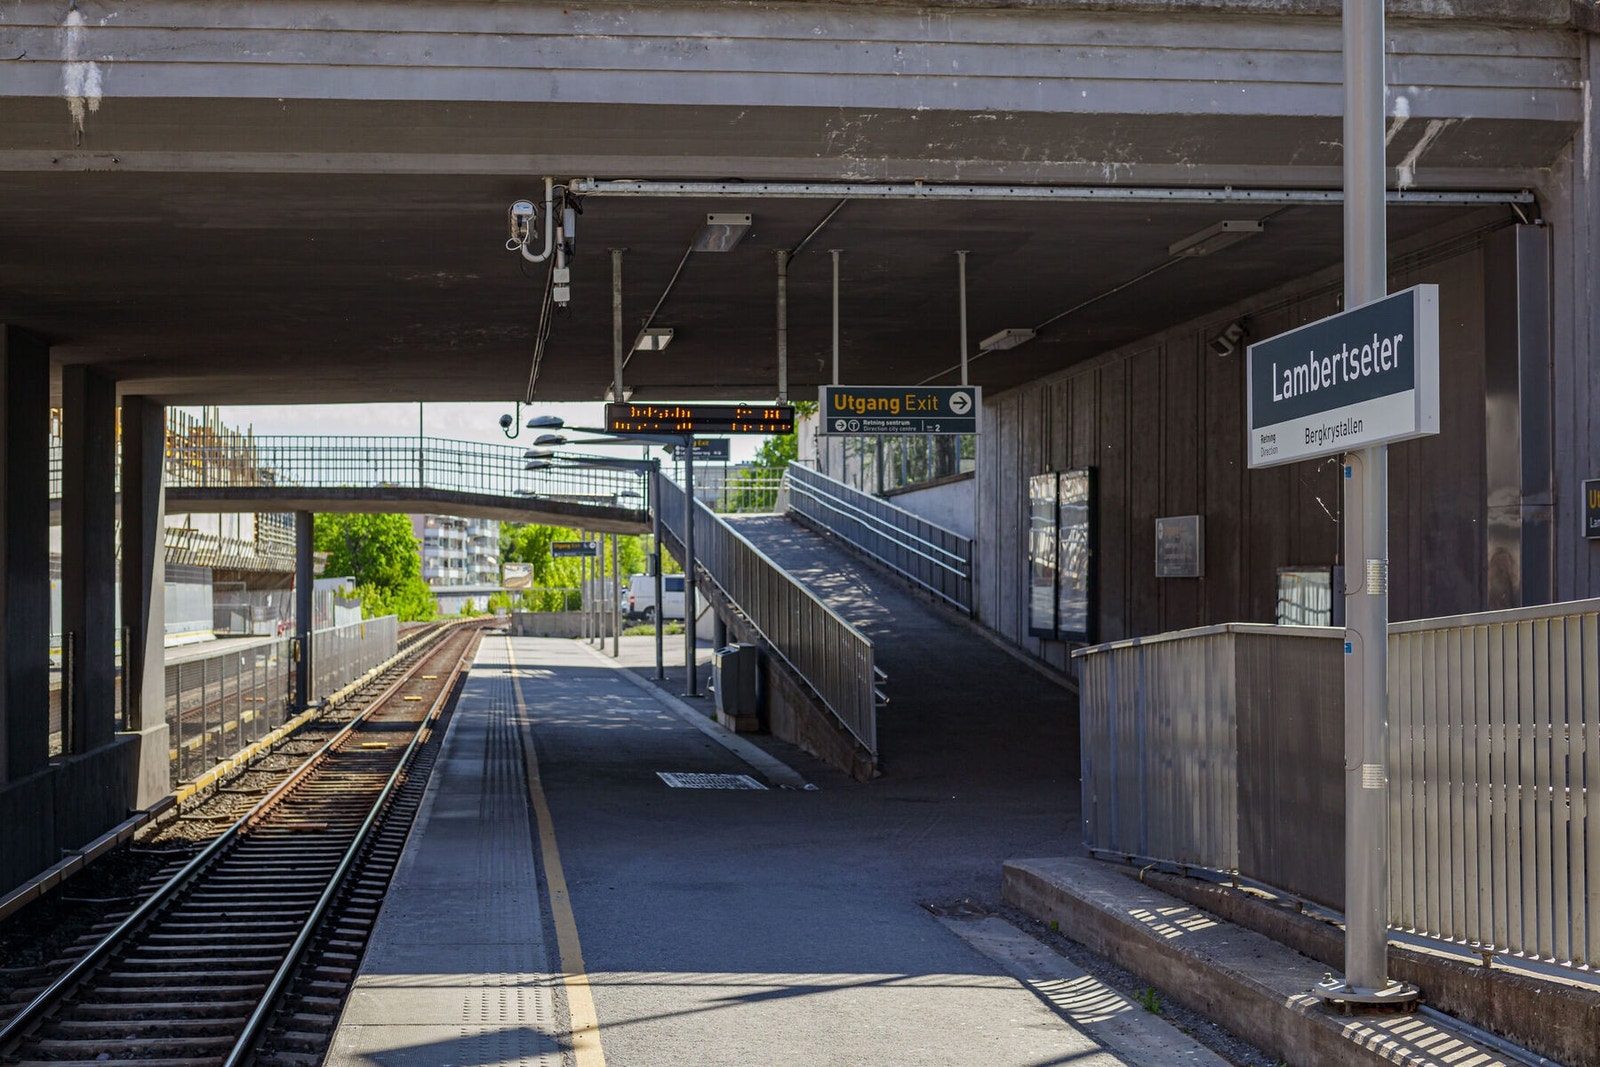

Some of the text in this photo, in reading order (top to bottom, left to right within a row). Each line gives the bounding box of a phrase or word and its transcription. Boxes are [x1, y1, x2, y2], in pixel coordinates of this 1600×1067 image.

[1272, 333, 1404, 402] Lambertseter
[834, 393, 939, 414] Utgang Exit
[888, 425, 898, 433] city
[934, 424, 941, 432] 2
[1305, 417, 1363, 447] Bergkrystallen
[1260, 433, 1276, 445] Retning
[1260, 445, 1278, 457] Direction
